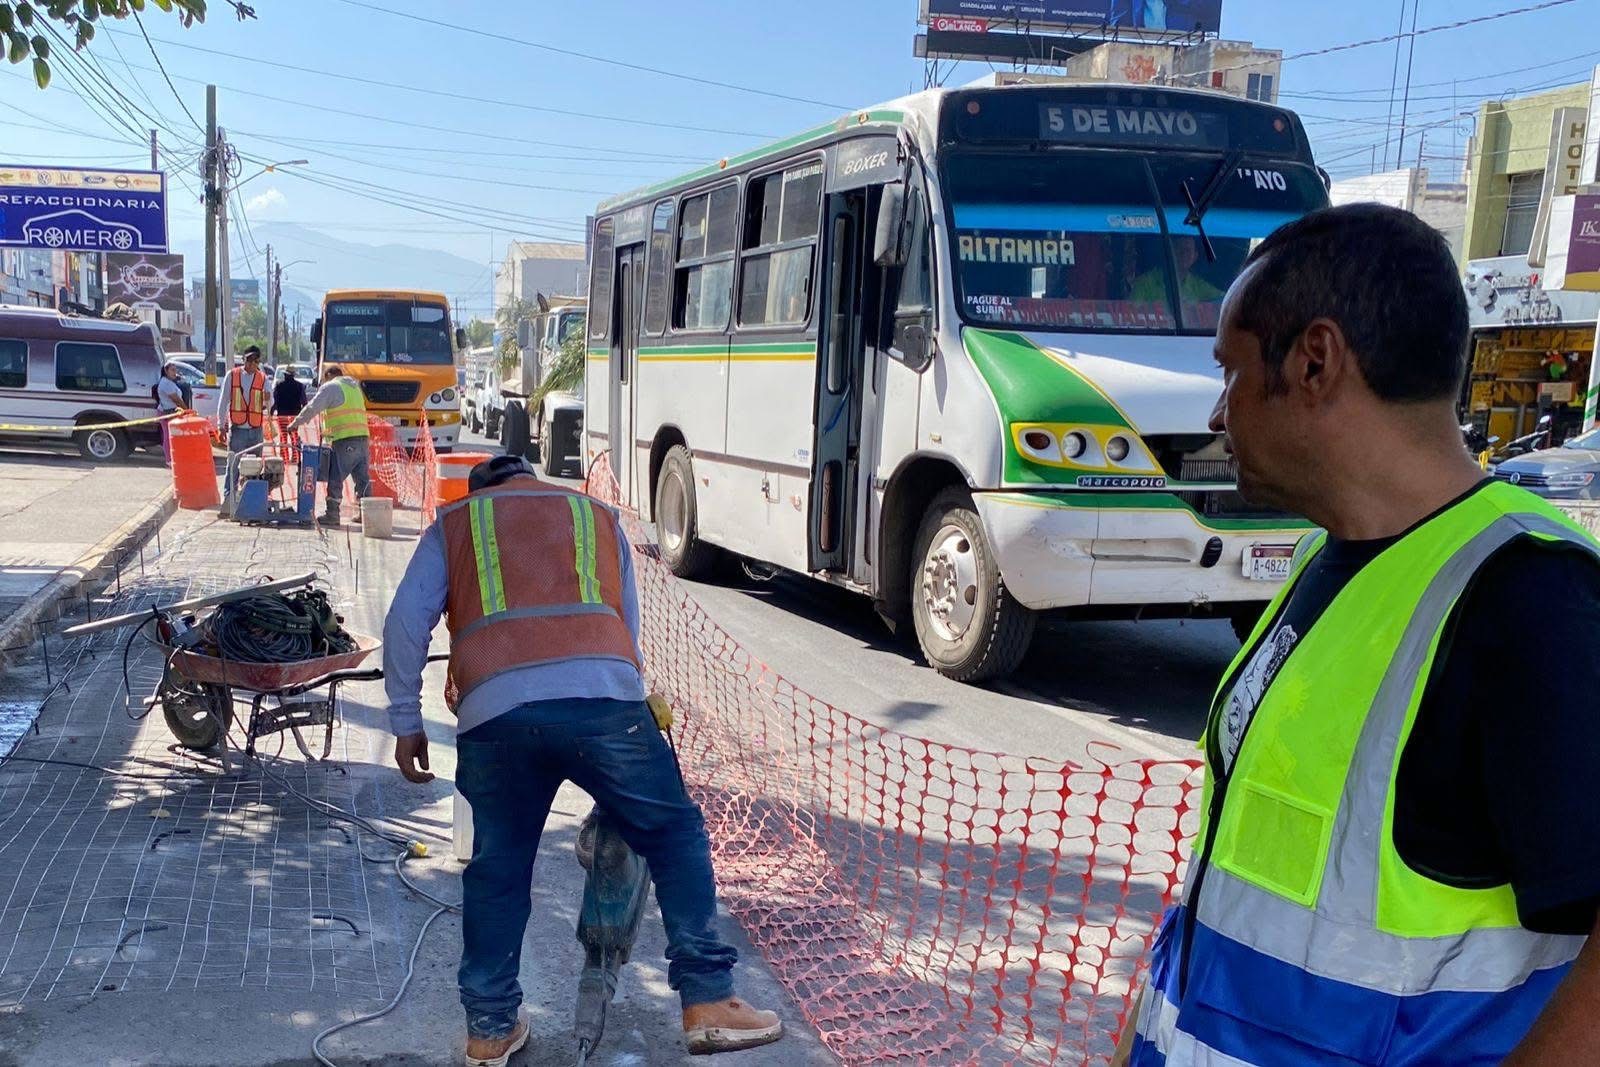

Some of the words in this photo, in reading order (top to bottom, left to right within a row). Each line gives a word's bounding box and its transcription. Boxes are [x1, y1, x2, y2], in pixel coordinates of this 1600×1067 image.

[959, 2, 997, 10] GUADALAJARA
[1049, 108, 1064, 132] 5
[1072, 109, 1110, 133] DE
[1117, 111, 1197, 136] MAYO
[843, 151, 889, 176] BOXER
[0, 194, 160, 210] REFACCIONARIA
[28, 226, 133, 250] ROMERO
[958, 235, 1076, 266] ALTAMIRA
[966, 295, 999, 305] PAGUE
[1000, 297, 1012, 306] AL
[975, 305, 1005, 315] SUBIR
[1081, 478, 1165, 487] Marcopolo
